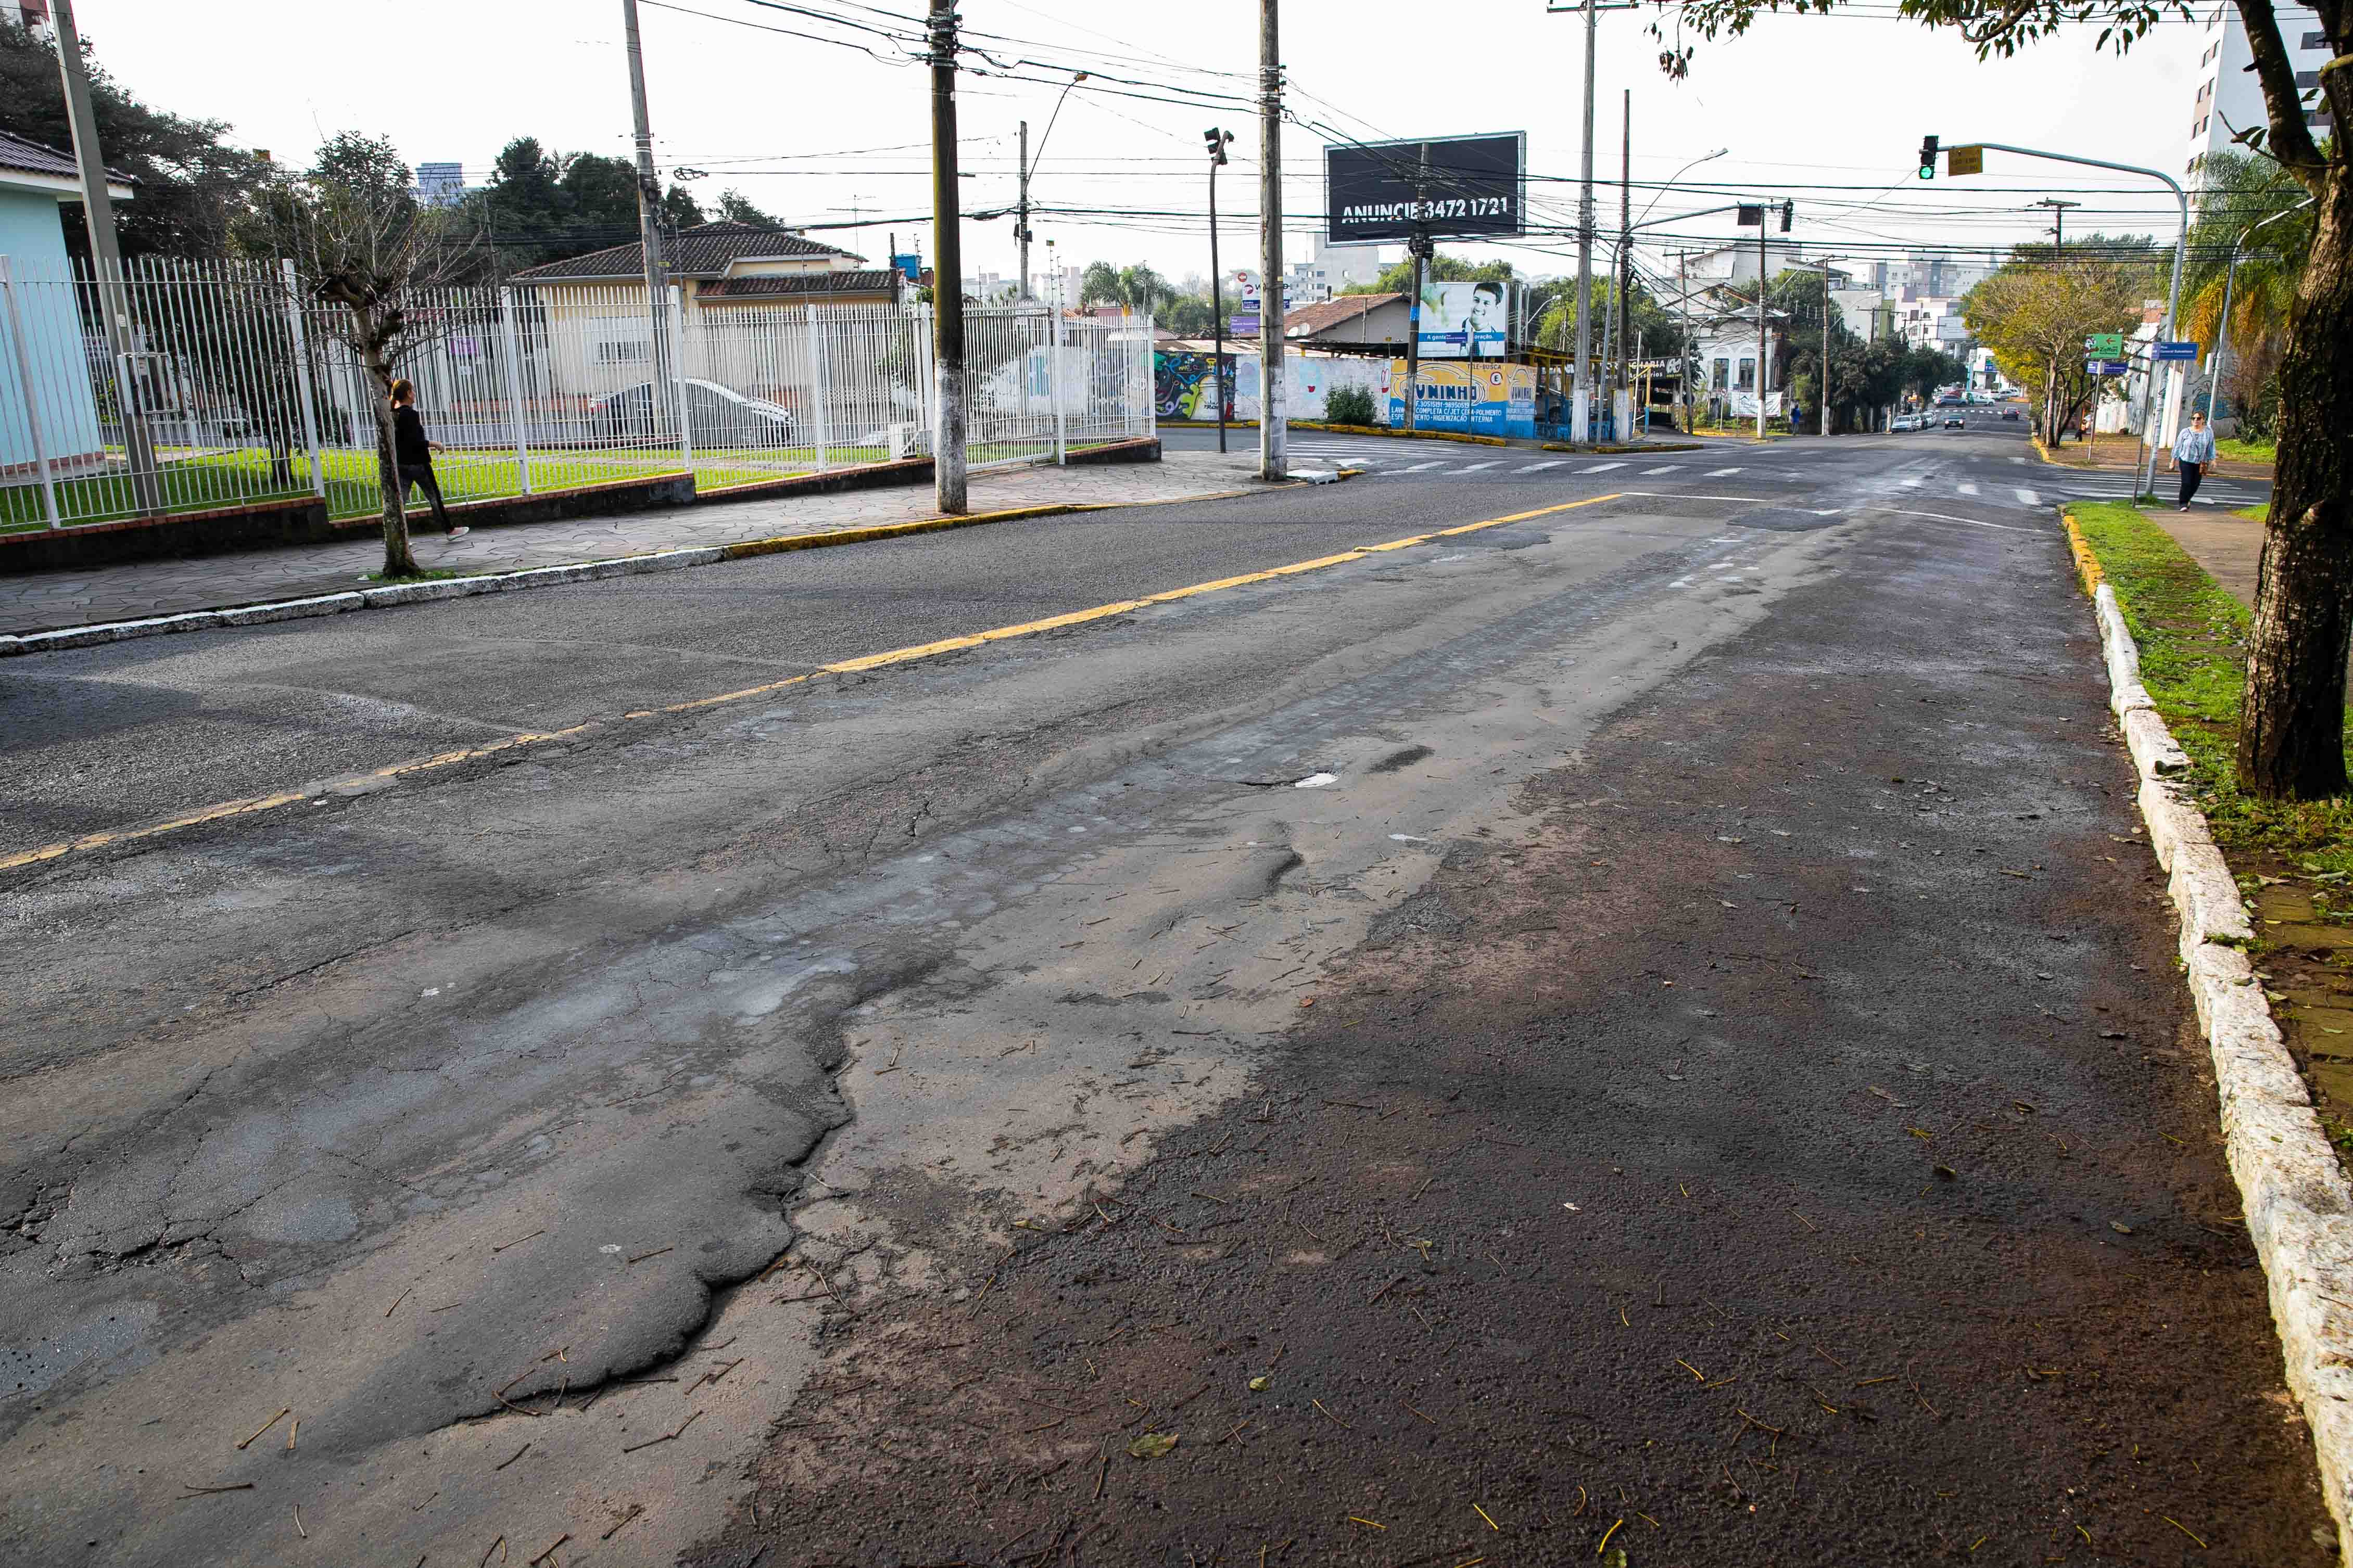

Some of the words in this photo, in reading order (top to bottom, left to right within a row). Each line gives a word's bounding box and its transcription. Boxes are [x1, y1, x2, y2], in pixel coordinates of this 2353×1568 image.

[1342, 202, 1418, 223] ANUNCIE
[1424, 199, 1465, 219] 3472
[1471, 197, 1507, 216] 1721
[1416, 384, 1477, 400] UNINHO
